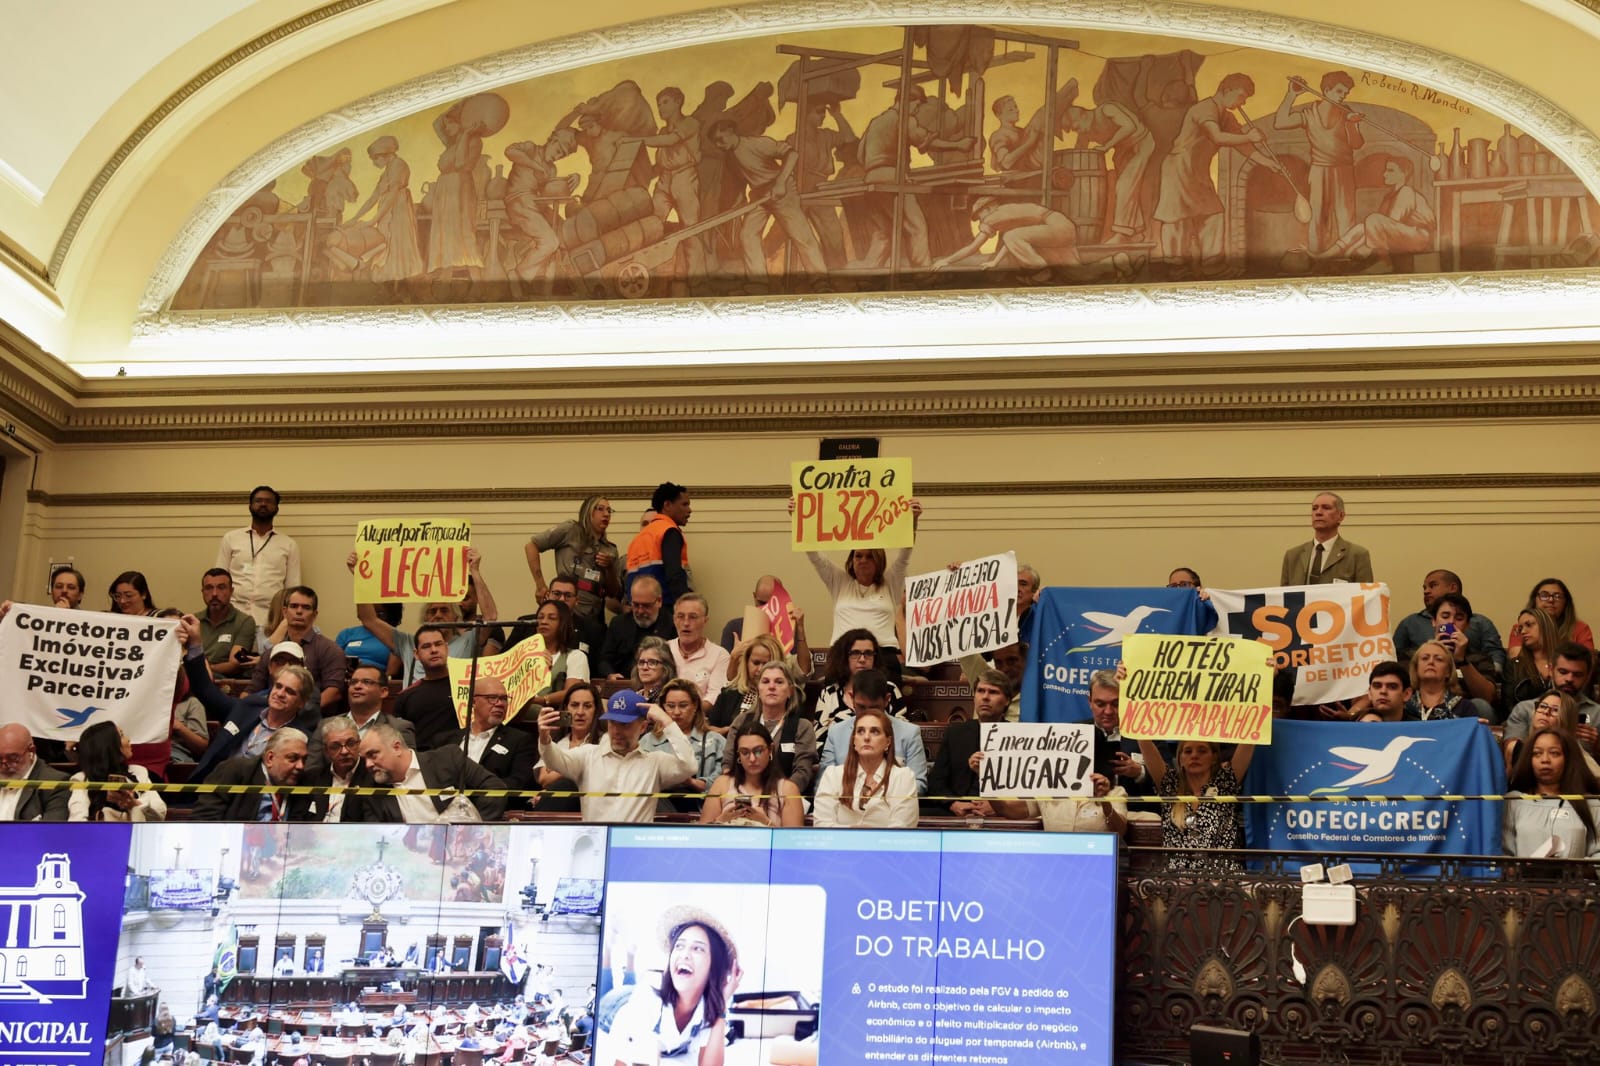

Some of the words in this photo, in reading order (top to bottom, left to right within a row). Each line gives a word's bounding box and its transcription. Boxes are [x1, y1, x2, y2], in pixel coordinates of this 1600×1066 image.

[1360, 71, 1407, 93] Roberto
[799, 464, 872, 490] Contra
[880, 468, 896, 488] a
[356, 523, 402, 545] Aluguel
[400, 527, 421, 547] por
[358, 550, 373, 579] é
[380, 546, 470, 598] LEGAL!
[911, 597, 943, 629] NÃO
[945, 582, 999, 619] MANDA
[16, 613, 130, 641] Corretora
[138, 625, 168, 642] de
[907, 623, 952, 663] NOSSA
[958, 598, 1016, 652] CASA!
[1252, 594, 1391, 651] SOU
[33, 635, 145, 662] Imóveis&
[1082, 655, 1119, 666] SISTE
[1153, 637, 1235, 671] HOTÉIS
[1273, 637, 1393, 670] ORRETOR
[19, 653, 145, 681] Exclusiva&
[1305, 669, 1328, 683] DE
[1332, 659, 1385, 681] IMÓVE
[1126, 669, 1202, 701] QUEREM
[1204, 672, 1262, 703] TIRAR
[1119, 701, 1177, 736] NOSSO
[1174, 703, 1271, 741] TRABALHO!
[984, 724, 999, 752] É
[999, 735, 1034, 752] meu
[1036, 725, 1089, 754] direito
[980, 755, 1092, 793] ALUGAR!
[1286, 832, 1319, 841] Conselho
[1320, 833, 1349, 842] Federal
[1350, 834, 1361, 842] de
[1362, 834, 1405, 843] Corretores
[1406, 834, 1417, 842] de
[857, 899, 984, 922] OBJETIVO
[855, 935, 894, 957] DO
[901, 936, 1046, 961] TRABALHO
[868, 983, 876, 993] O
[878, 983, 909, 993] estudo
[911, 984, 923, 994] foi
[925, 985, 967, 995] realizado
[970, 986, 989, 996] pela
[991, 986, 1012, 996] FGV
[1022, 987, 1054, 998] pedido
[1056, 989, 1069, 998] do
[867, 1000, 900, 1011] Airbnb,
[902, 1001, 921, 1010] com
[933, 1002, 970, 1013] objetivo
[973, 1003, 984, 1012] de
[987, 1004, 1022, 1014] calcular
[1024, 1006, 1031, 1014] o
[1033, 1005, 1071, 1016] impacto
[866, 1017, 915, 1027] econômico
[918, 1019, 924, 1027] e
[926, 1019, 932, 1027] o
[935, 1018, 962, 1028] efeito
[964, 1020, 1024, 1031] multiplicador
[1026, 1022, 1038, 1031] do
[1041, 1022, 1079, 1033] negócio
[866, 1033, 913, 1044] imobiliário
[915, 1035, 927, 1044] do
[930, 1036, 963, 1047] aluguel
[965, 1038, 981, 1047] por
[984, 1037, 1034, 1049] temporada
[1080, 1042, 1087, 1050] e
[865, 1051, 906, 1061] entender
[907, 1053, 918, 1062] os
[920, 1052, 967, 1063] diferentes
[969, 1054, 1008, 1065] retornos
